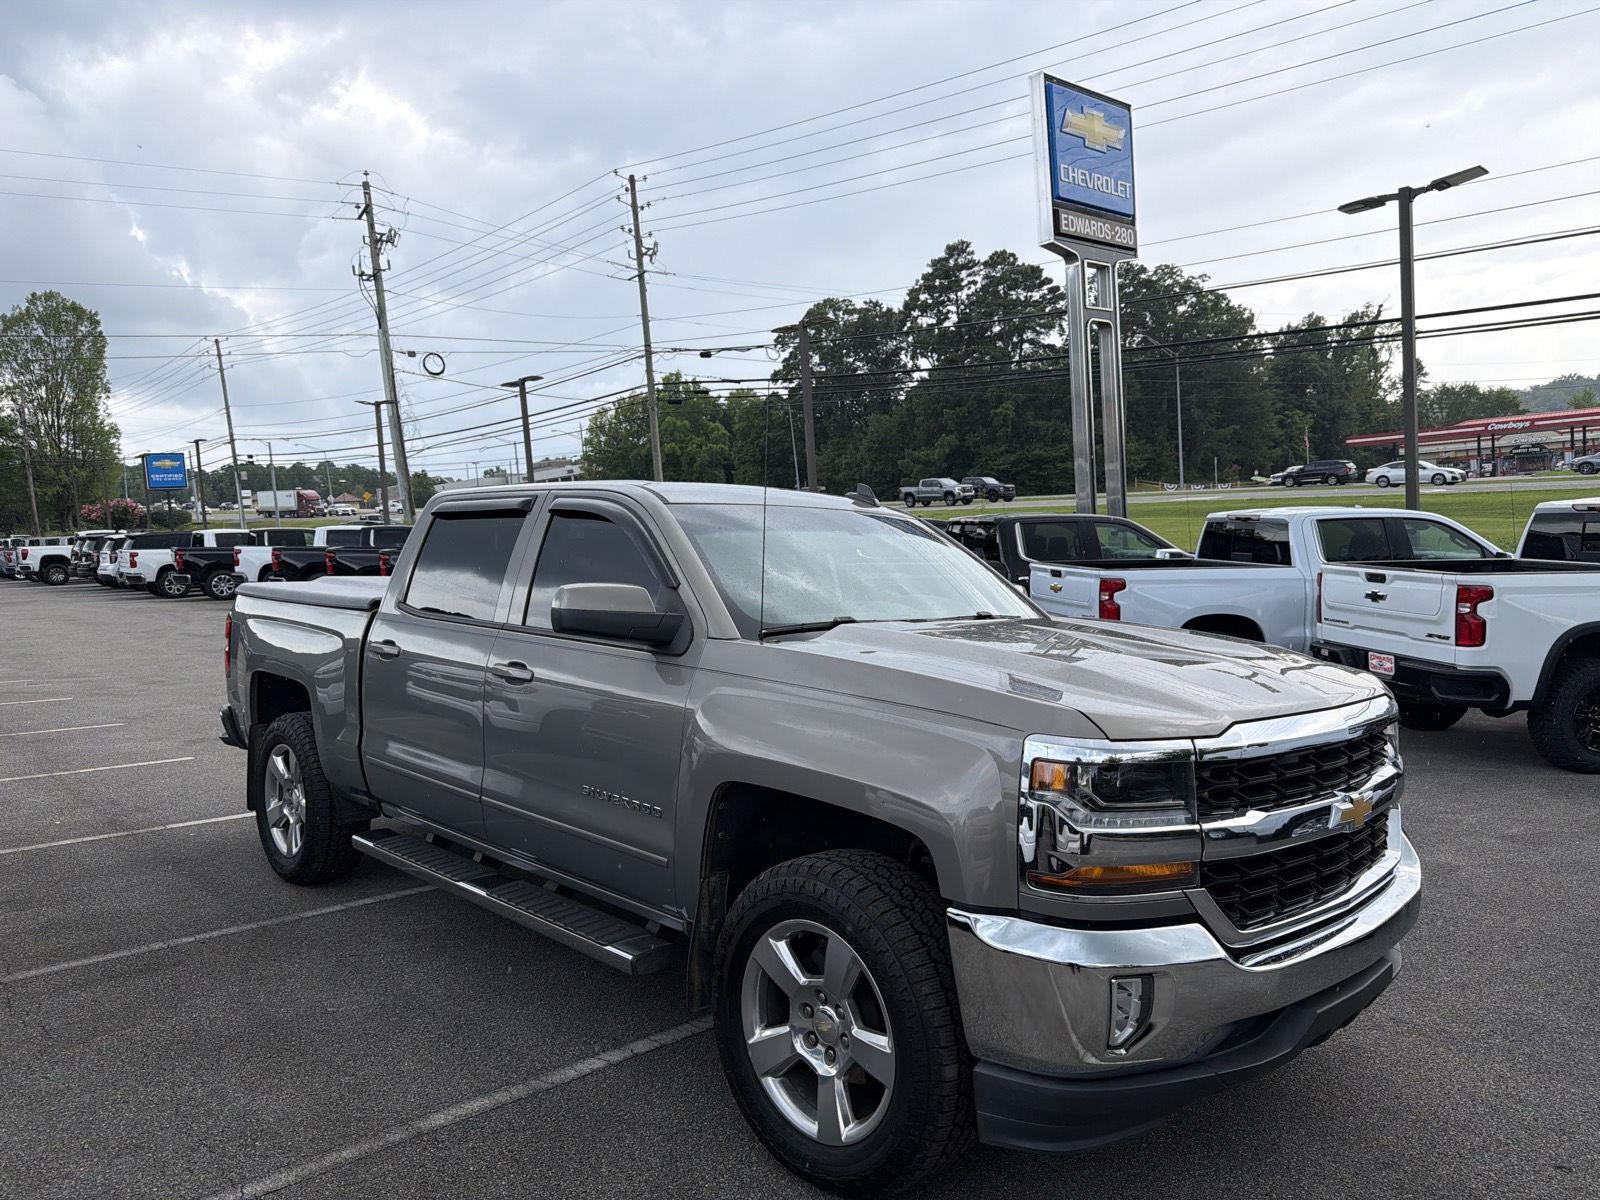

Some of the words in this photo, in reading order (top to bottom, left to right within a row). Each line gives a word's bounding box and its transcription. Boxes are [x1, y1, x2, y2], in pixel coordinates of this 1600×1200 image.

[1060, 163, 1131, 199] CHEVROLET
[1487, 421, 1531, 431] Cowboys
[582, 785, 663, 819] SILVERADO
